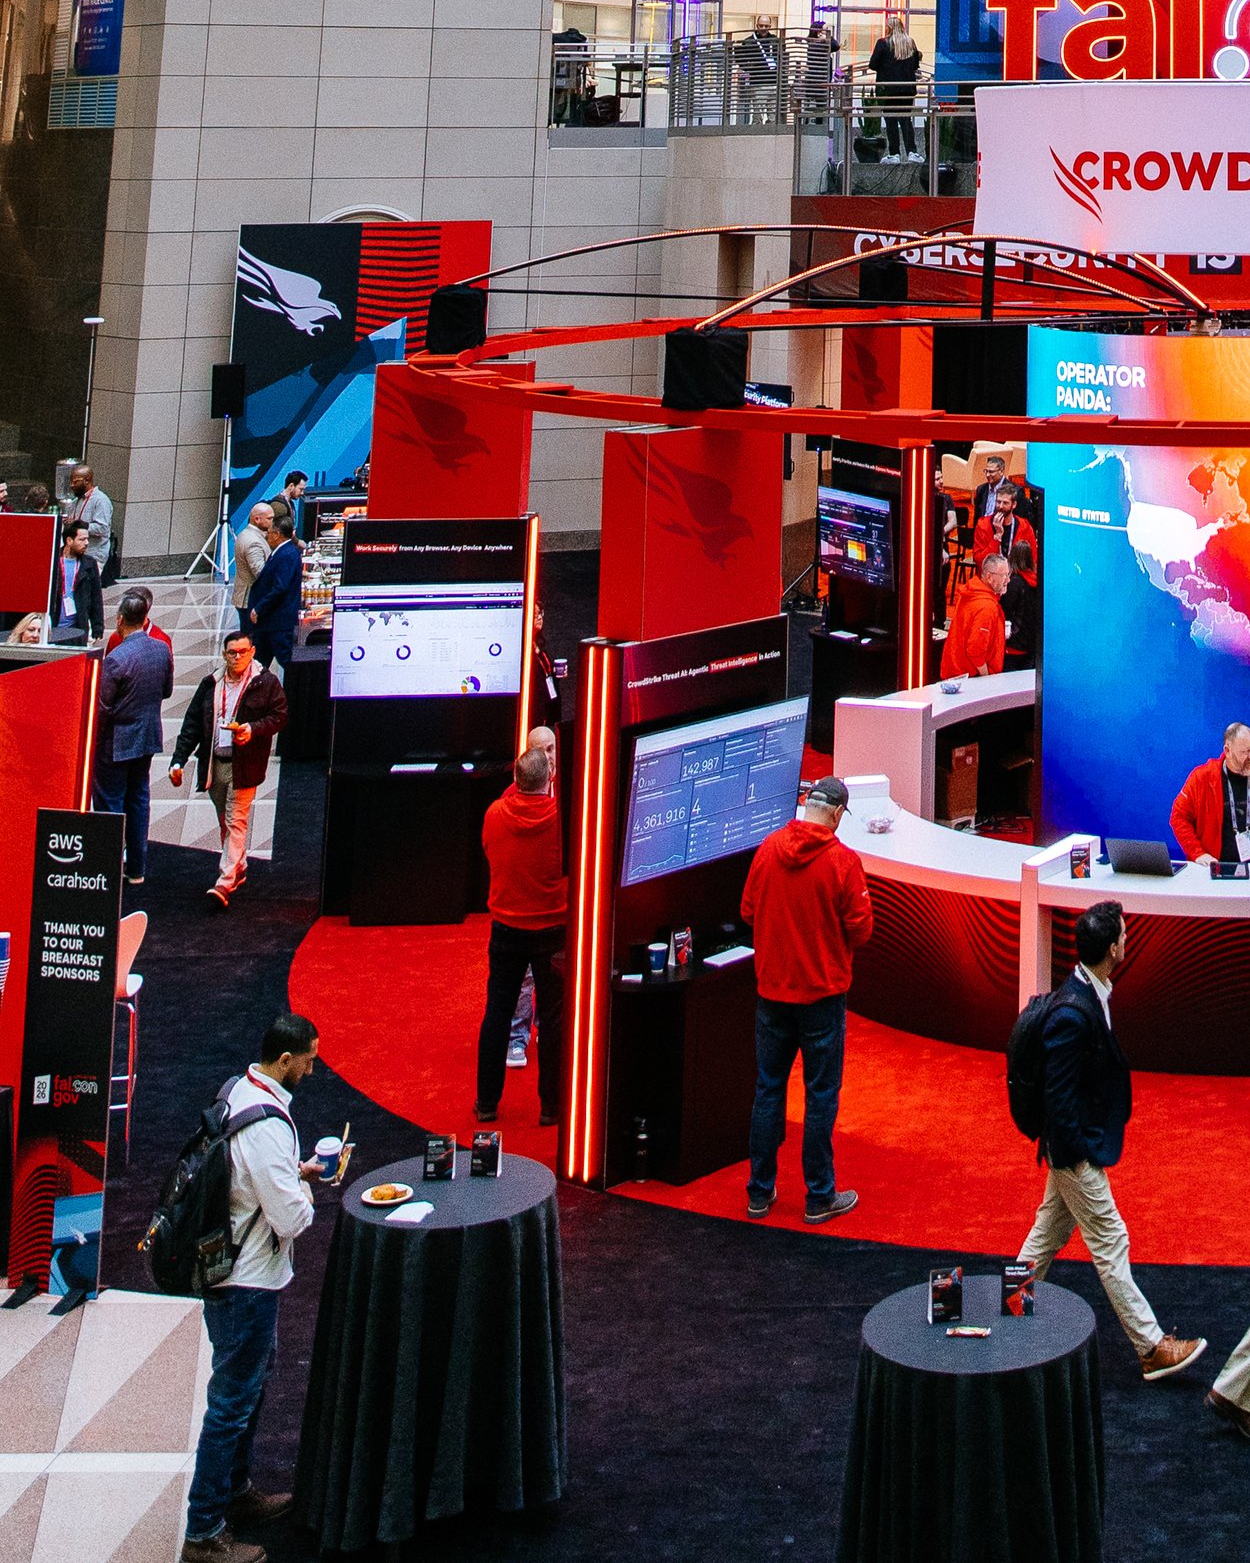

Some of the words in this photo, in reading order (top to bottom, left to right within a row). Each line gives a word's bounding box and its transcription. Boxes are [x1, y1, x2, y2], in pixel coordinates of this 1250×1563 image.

[1056, 360, 1146, 388] OPERATOR
[1056, 385, 1112, 413] PANDA:
[1081, 508, 1111, 523] STATES
[356, 544, 371, 552] Work
[372, 544, 398, 553] Securely
[414, 544, 425, 553] Any
[450, 544, 462, 553] Any
[462, 543, 483, 551] Device
[484, 543, 513, 553] Anywhere
[627, 675, 662, 689] CrowdStrike
[662, 671, 680, 682] Threat
[688, 664, 709, 677] Agentic
[710, 660, 728, 671] Threat
[728, 655, 758, 668] Intelligence
[764, 649, 781, 660] Action
[692, 798, 701, 815] 4
[48, 833, 83, 851] aws
[47, 871, 108, 891] carahsoft
[44, 921, 81, 936] THANK
[82, 923, 105, 938] YOU
[42, 936, 58, 948] TO
[59, 937, 84, 951] OUR
[41, 950, 104, 968] BREAKFAST
[40, 965, 101, 982] SPONSORS
[36, 1080, 47, 1090] 20
[36, 1090, 46, 1099] 26
[53, 1091, 79, 1108] gov
